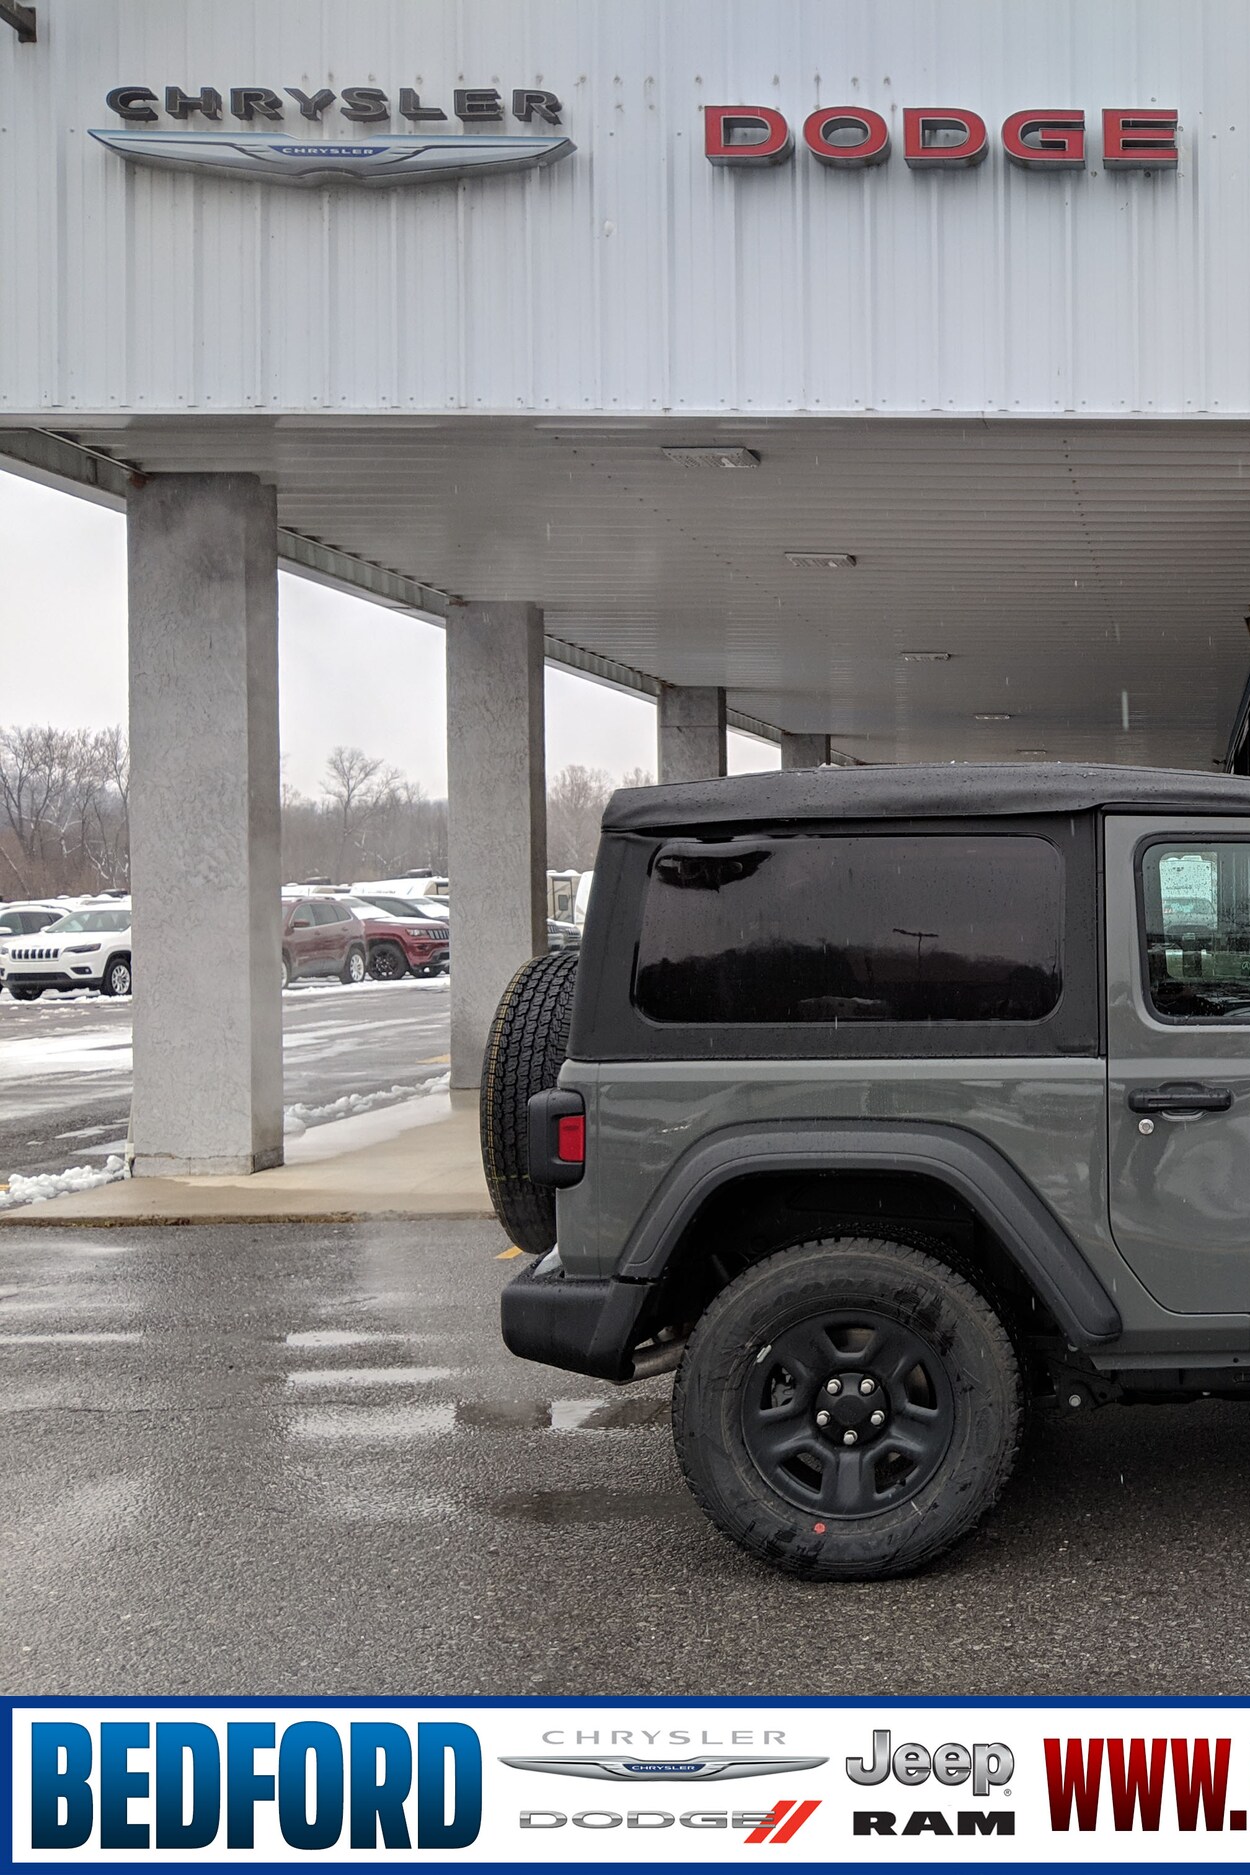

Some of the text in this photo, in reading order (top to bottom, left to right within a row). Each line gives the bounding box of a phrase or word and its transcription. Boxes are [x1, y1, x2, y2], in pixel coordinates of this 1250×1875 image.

[106, 86, 562, 125] CHRYSLER
[281, 147, 375, 155] CHRYSLER
[704, 105, 1178, 169] DODGE
